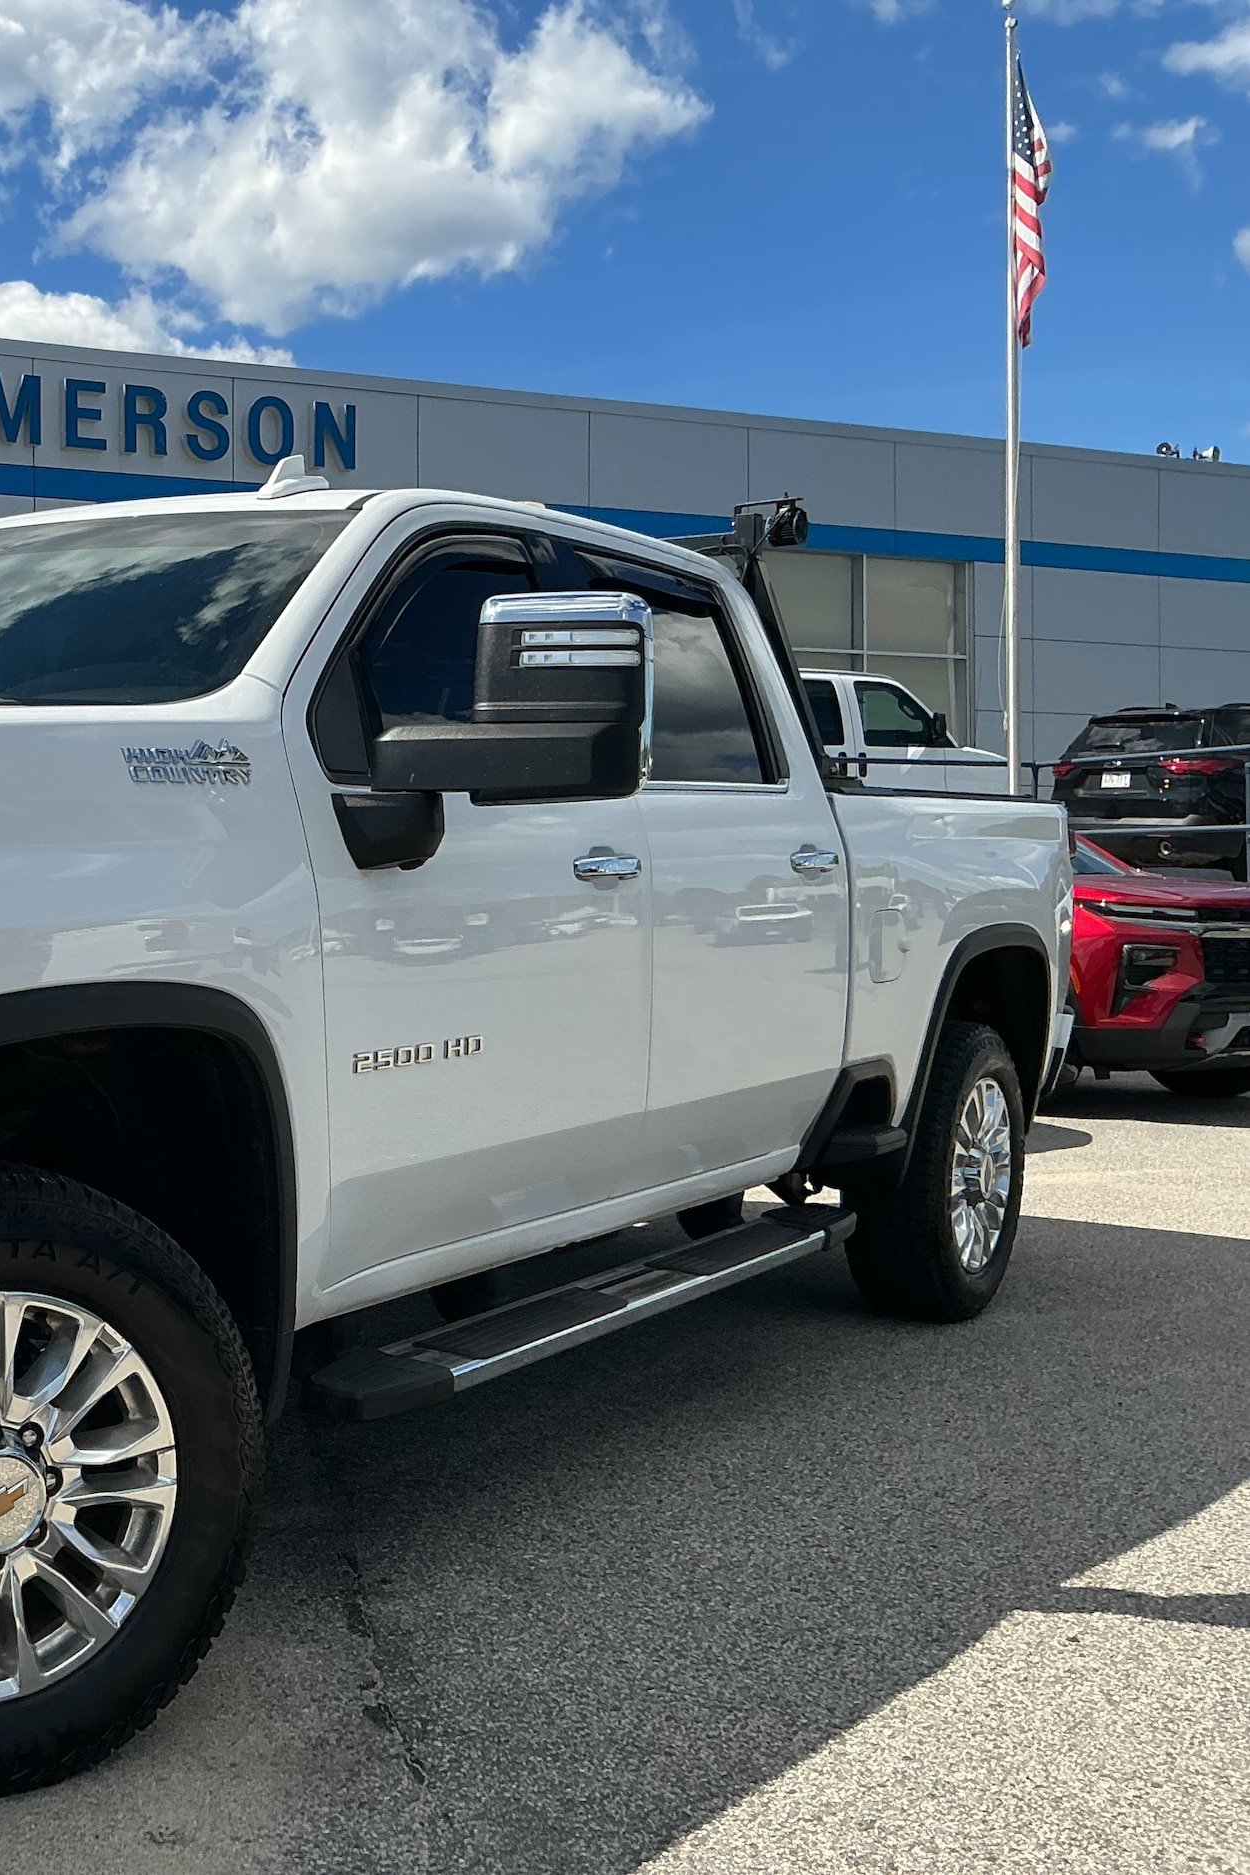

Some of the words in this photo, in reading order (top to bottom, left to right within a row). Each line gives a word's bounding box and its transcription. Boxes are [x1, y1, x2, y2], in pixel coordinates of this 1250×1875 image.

[121, 745, 191, 765] HIGH
[129, 765, 251, 785] COUNTRY
[353, 1042, 435, 1074] 2500
[443, 1035, 485, 1059] HD
